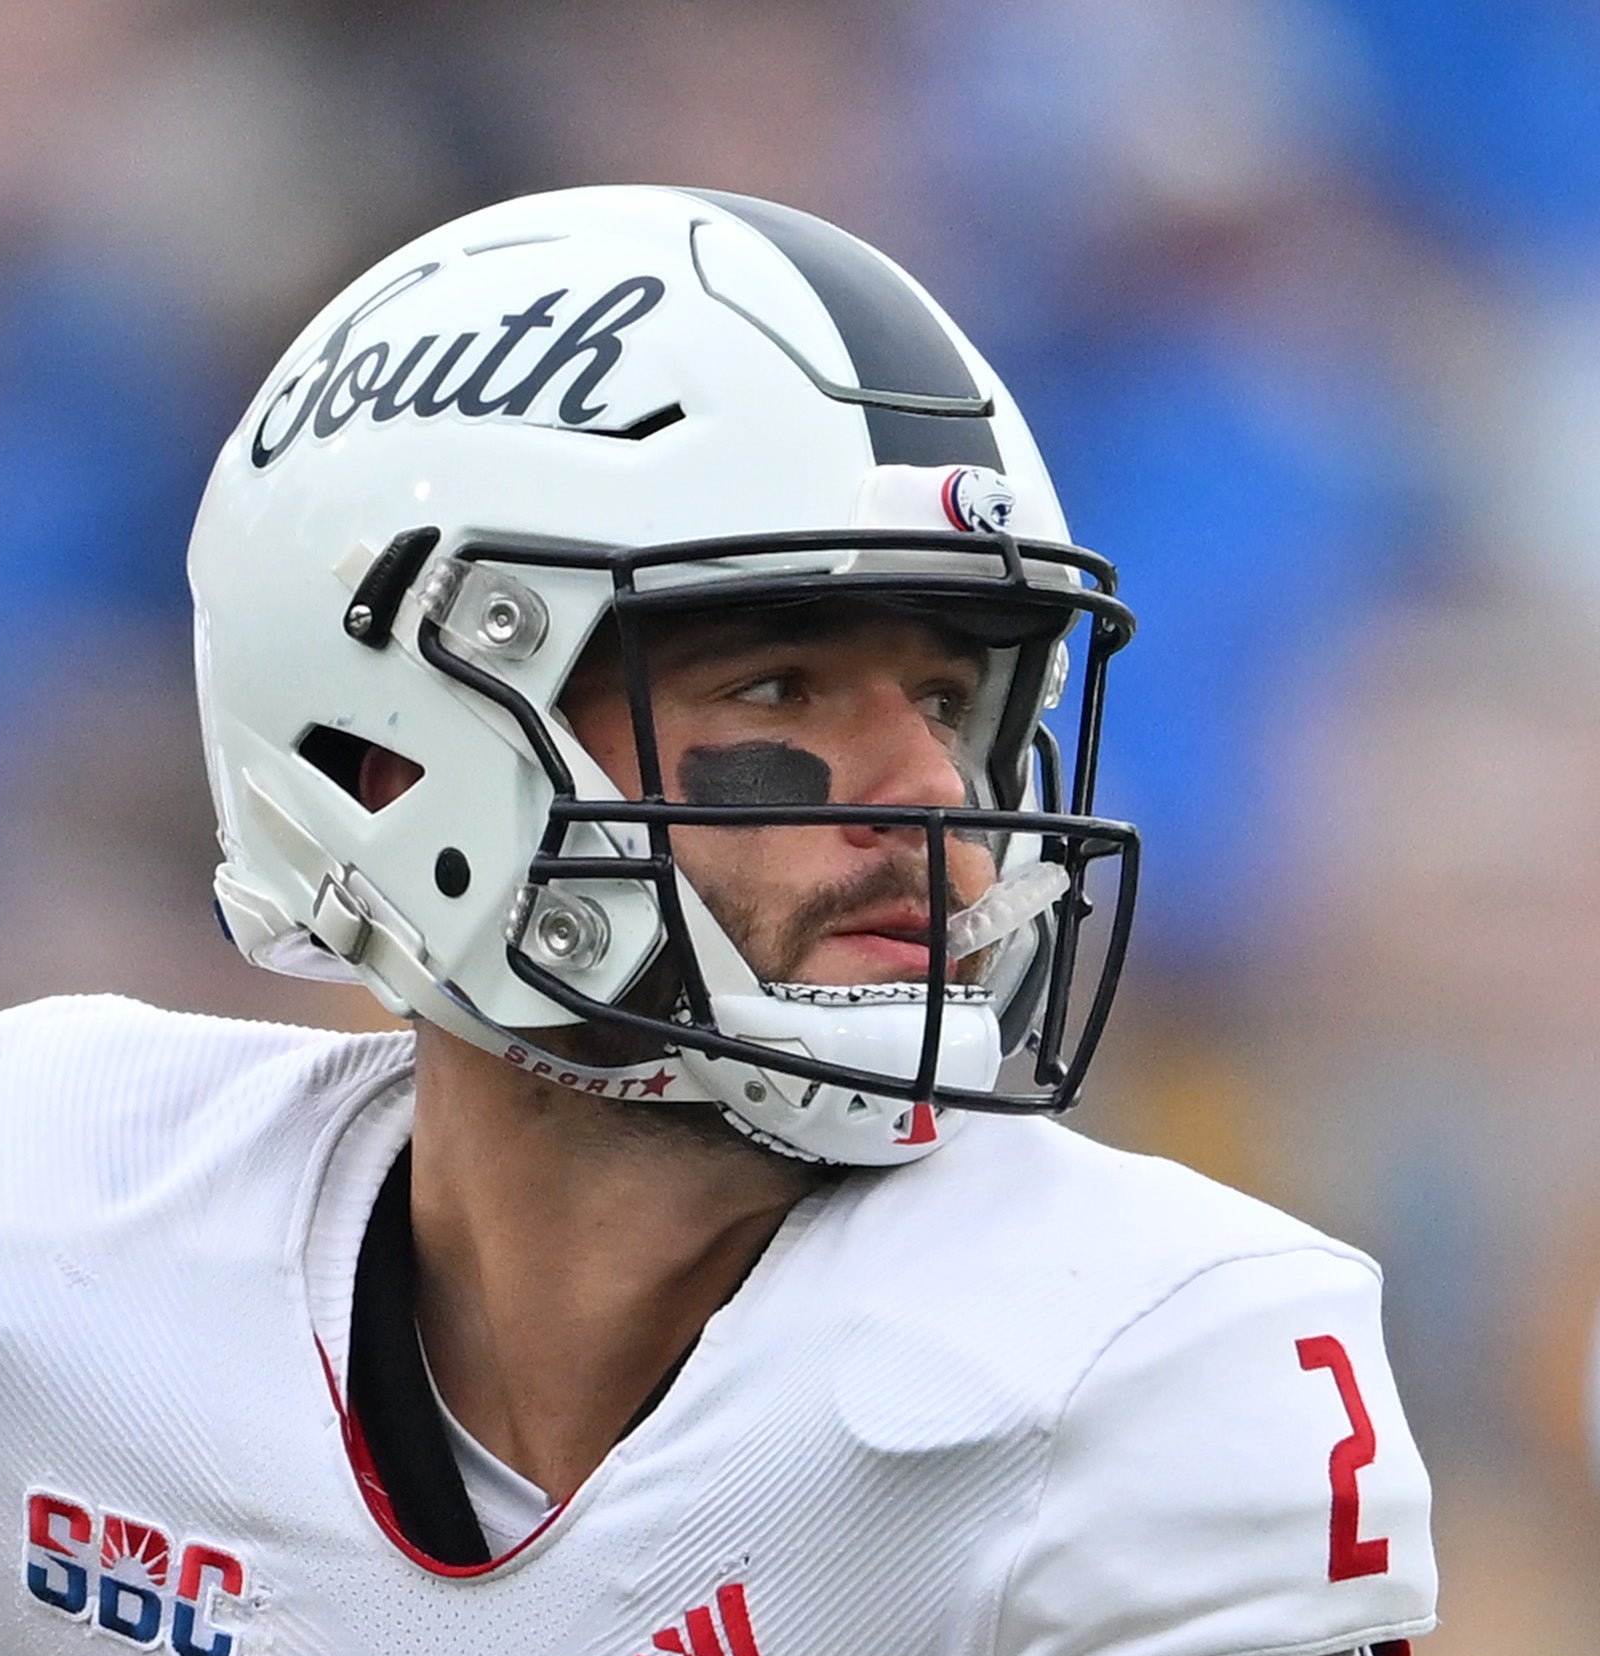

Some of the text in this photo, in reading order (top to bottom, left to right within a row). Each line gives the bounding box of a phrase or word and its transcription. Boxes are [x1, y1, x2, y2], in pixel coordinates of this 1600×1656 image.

[251, 260, 666, 469] South
[503, 1044, 639, 1099] SPORT
[1295, 1335, 1389, 1582] 2
